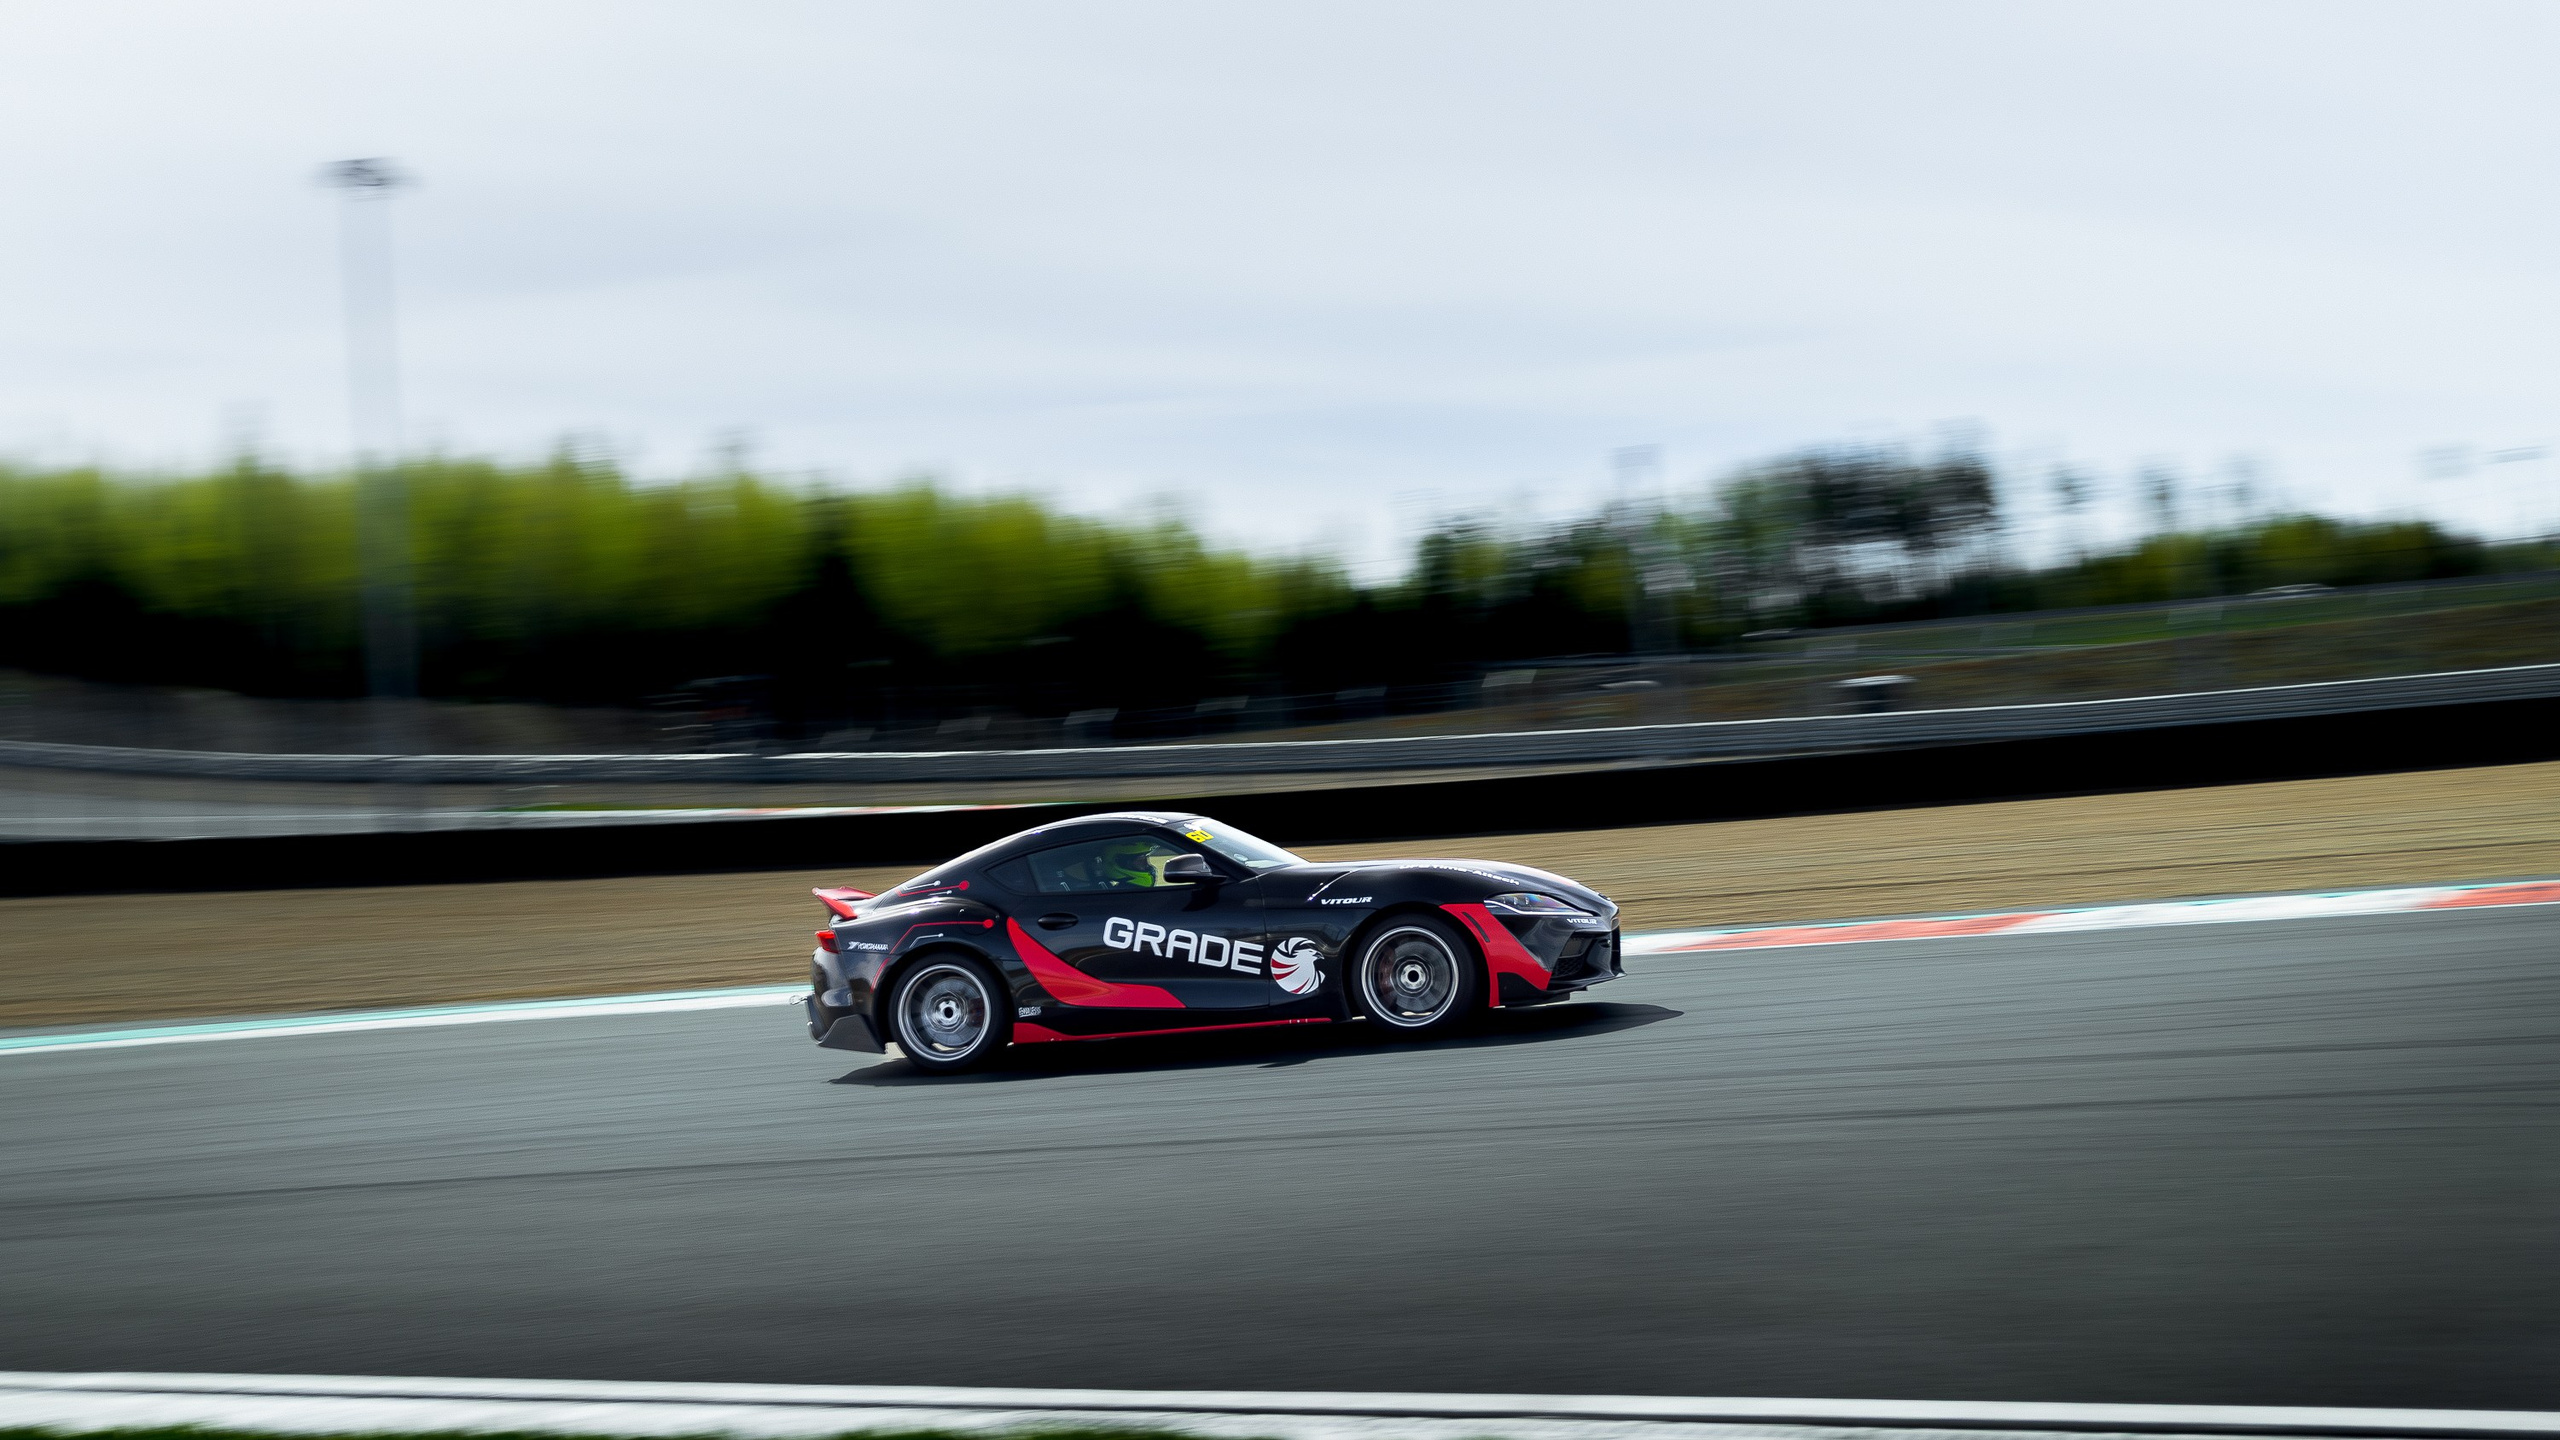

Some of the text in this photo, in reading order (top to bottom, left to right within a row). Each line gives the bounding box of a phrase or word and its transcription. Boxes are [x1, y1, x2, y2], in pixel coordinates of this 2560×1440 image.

[1185, 830, 1214, 843] 60
[1321, 896, 1373, 905] VITOUR
[1102, 916, 1265, 975] GRADE
